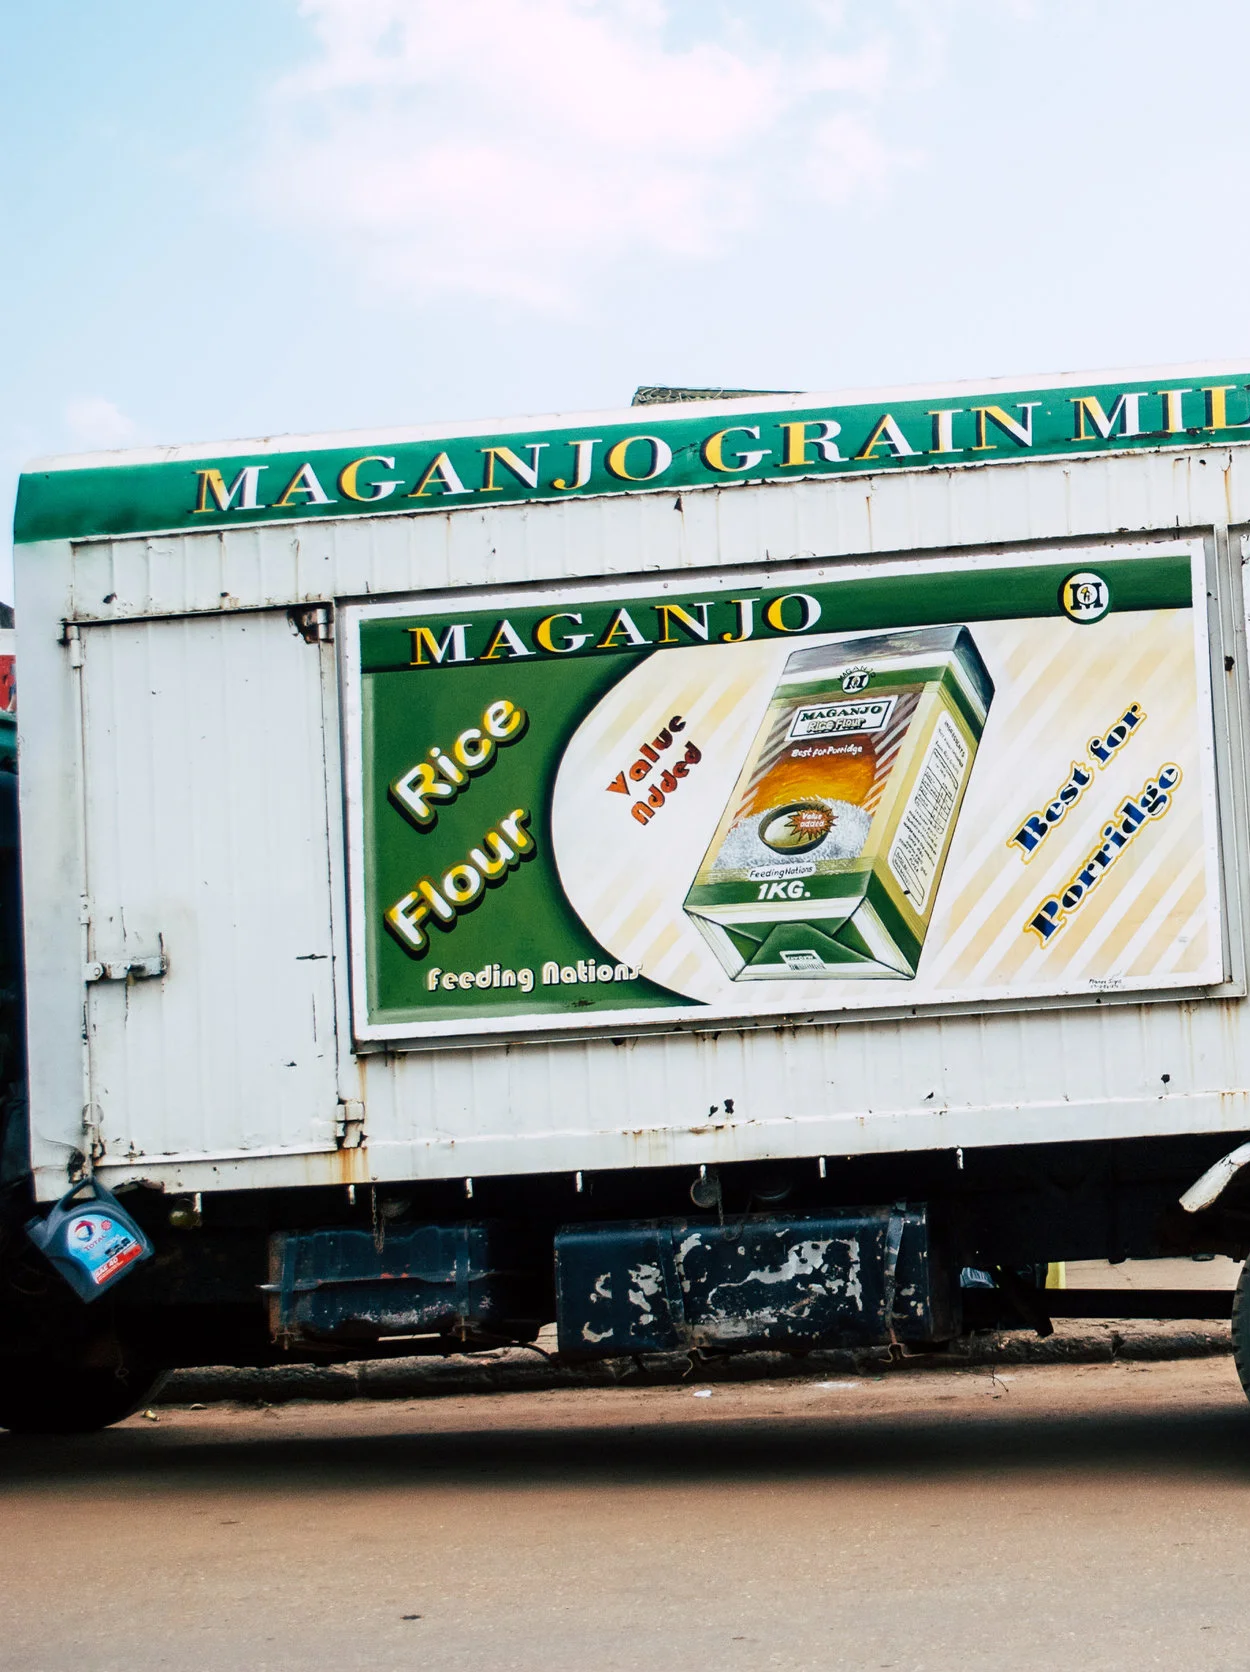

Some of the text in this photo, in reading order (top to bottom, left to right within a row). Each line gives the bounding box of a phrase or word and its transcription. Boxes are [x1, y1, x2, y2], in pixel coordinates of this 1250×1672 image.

[192, 435, 673, 514] MAGANJO
[700, 402, 1042, 473] GRAIN
[408, 594, 821, 666] MAGANJO
[791, 743, 863, 758] Best for Porridge
[800, 705, 882, 722] MAGANJO
[390, 698, 527, 830] Rice
[606, 715, 687, 795] Value
[1007, 702, 1147, 864] Best for
[385, 807, 536, 957] Flour
[1024, 763, 1183, 949] Porridge
[427, 959, 643, 992] Feeding Nations
[84, 1234, 107, 1251] TOTAL
